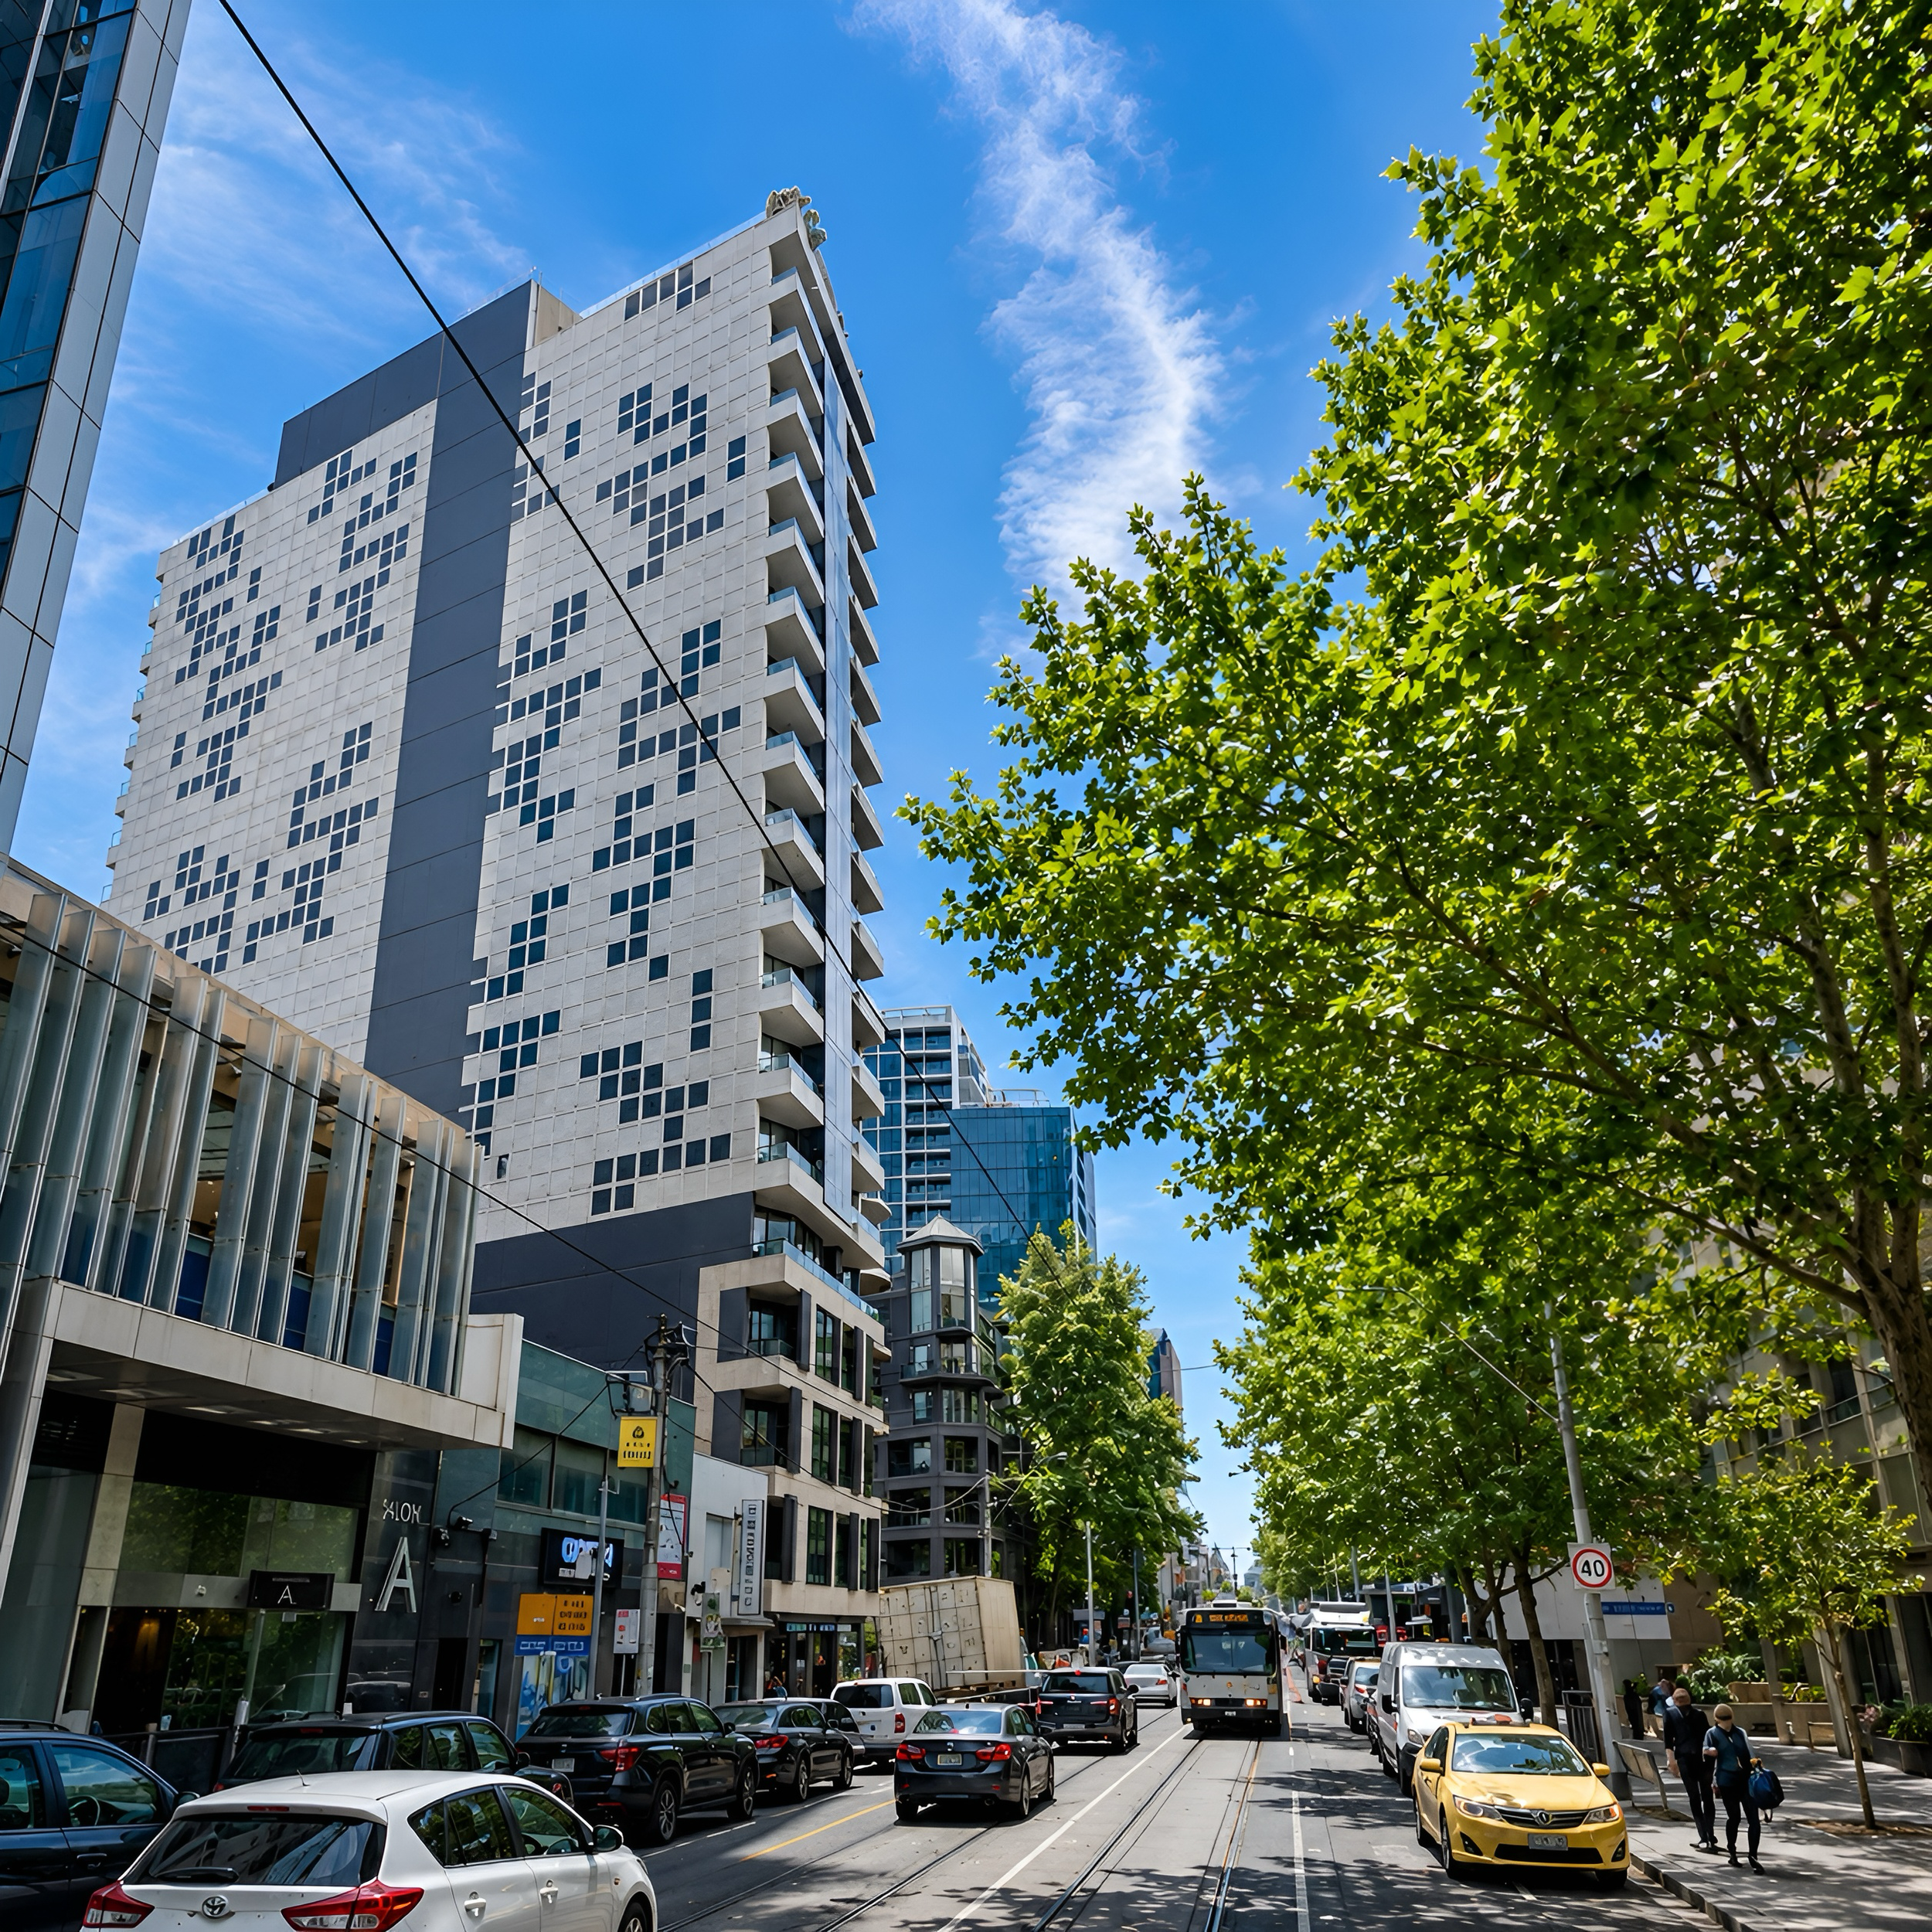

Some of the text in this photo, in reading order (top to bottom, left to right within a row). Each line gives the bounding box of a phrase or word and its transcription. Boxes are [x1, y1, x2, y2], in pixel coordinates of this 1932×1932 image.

[374, 1536, 417, 1613] A
[1581, 1560, 1604, 1577] 40
[277, 1584, 293, 1604] A
